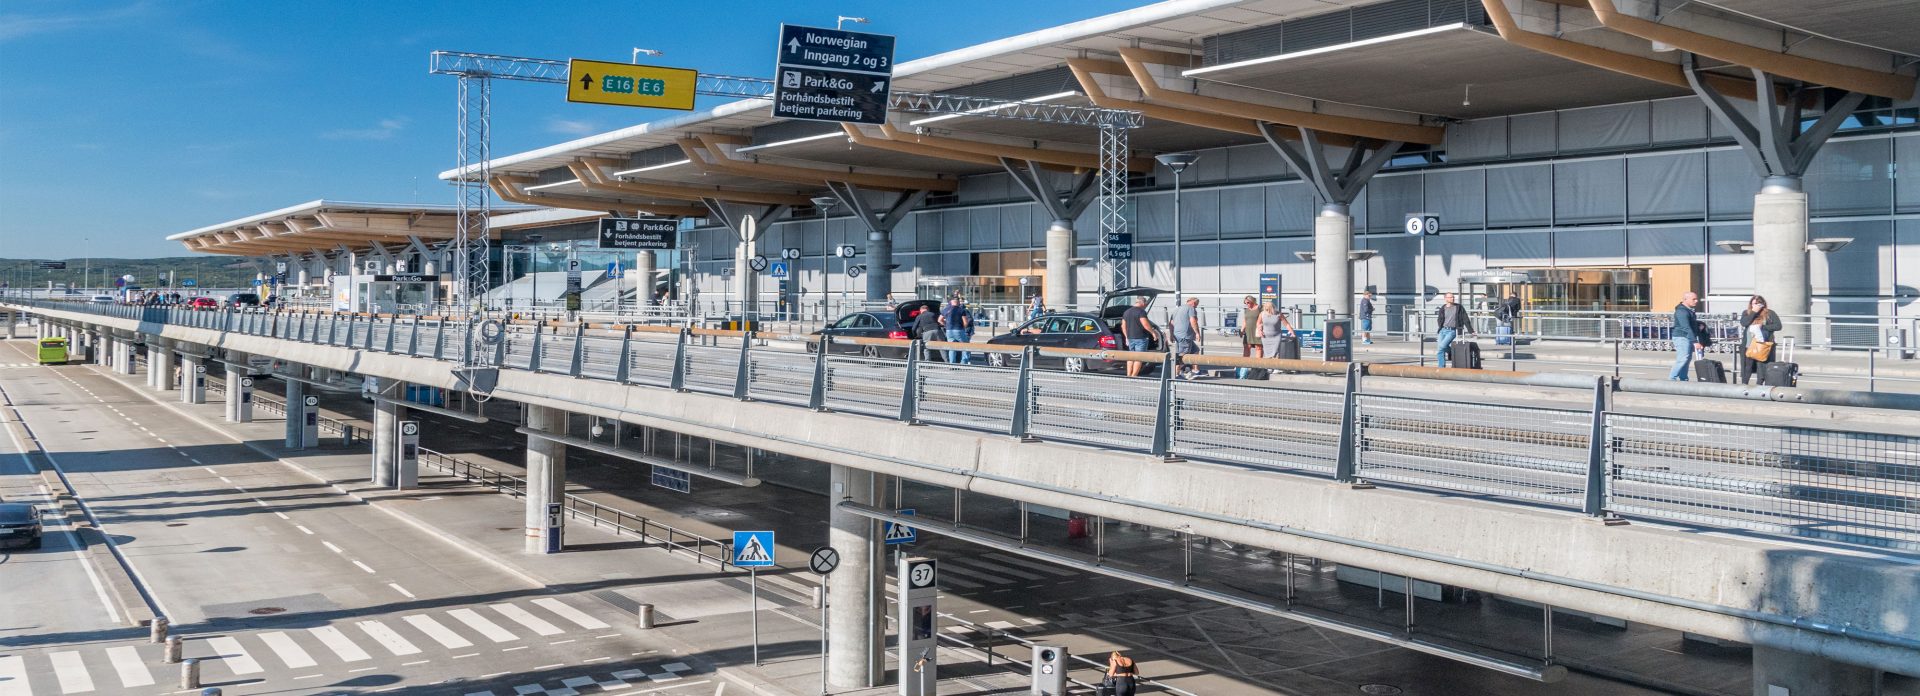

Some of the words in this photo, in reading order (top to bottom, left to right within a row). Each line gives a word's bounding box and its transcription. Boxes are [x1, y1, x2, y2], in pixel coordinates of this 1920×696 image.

[806, 32, 867, 49] Norwegian
[804, 49, 850, 66] Inngang
[853, 54, 860, 64] 2
[863, 57, 877, 68] og
[880, 56, 887, 67] 3
[606, 79, 613, 89] E
[617, 80, 631, 90] 16
[642, 82, 650, 91] E
[653, 83, 661, 92] 6
[804, 75, 853, 90] Park&Go
[781, 91, 855, 106] Forhåndsbestilt
[780, 102, 814, 115] betjent
[816, 107, 862, 120] parkering
[643, 223, 674, 232] Park&Go
[1412, 221, 1418, 230] 6
[1429, 220, 1435, 231] 6
[638, 241, 668, 249] parkering
[571, 261, 579, 270] P
[406, 425, 415, 433] 39
[915, 569, 930, 581] 37
